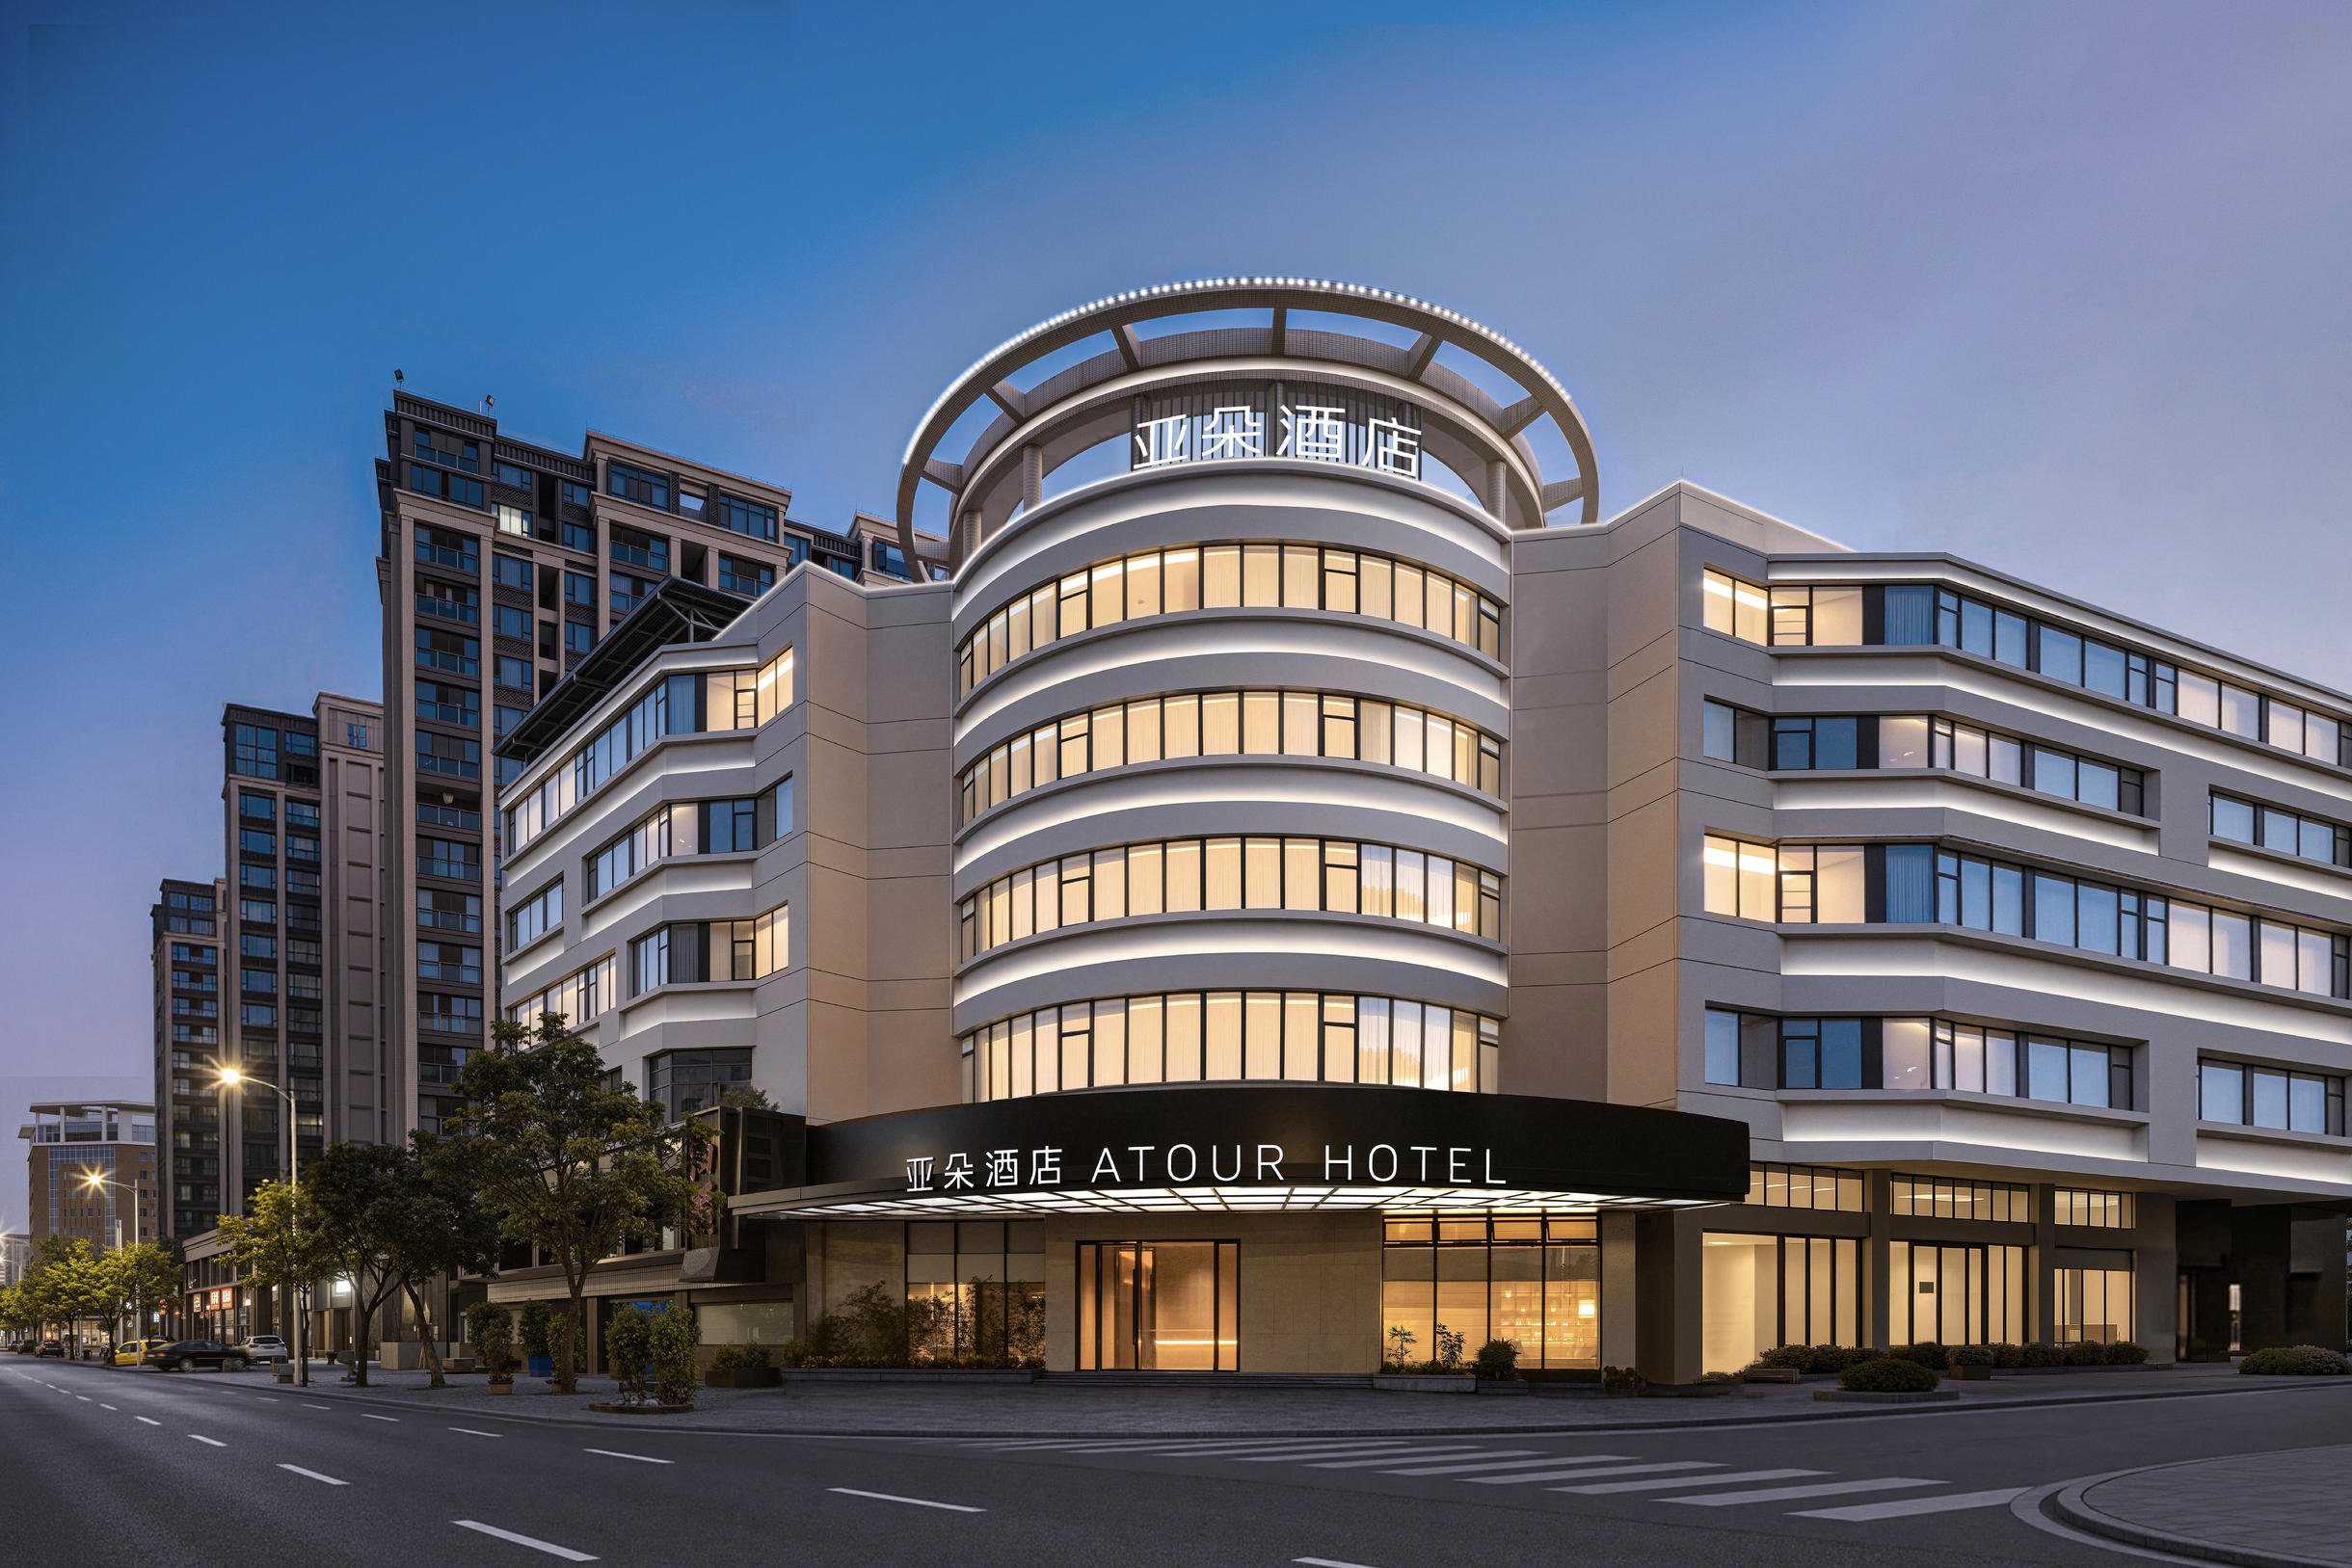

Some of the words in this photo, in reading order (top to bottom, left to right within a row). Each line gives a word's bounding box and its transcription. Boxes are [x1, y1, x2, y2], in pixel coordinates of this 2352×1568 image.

[1133, 404, 1422, 478] 亚朵酒店
[905, 1145, 1062, 1192] 亚朵酒店
[1091, 1144, 1284, 1183] ATOUR
[1324, 1144, 1507, 1184] HOTEL
